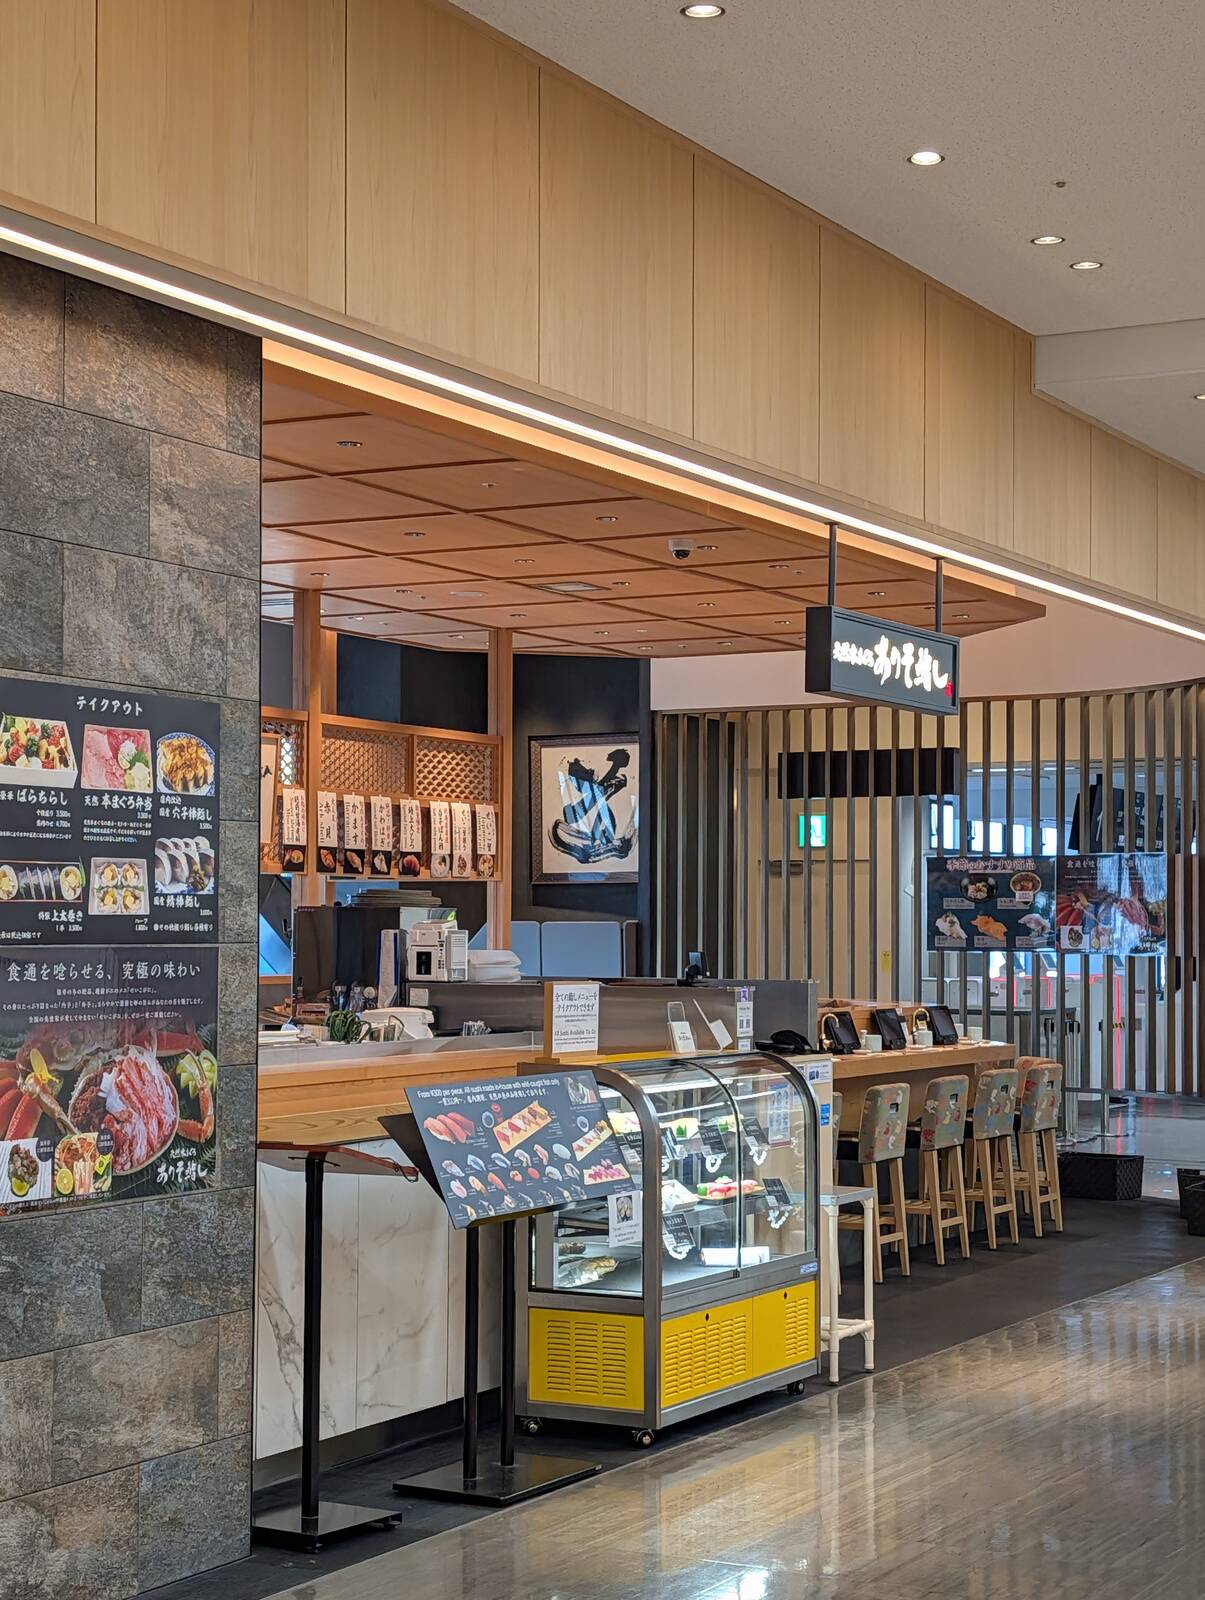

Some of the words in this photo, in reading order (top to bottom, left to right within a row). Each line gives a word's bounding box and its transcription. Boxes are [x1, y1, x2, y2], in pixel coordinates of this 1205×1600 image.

[76, 696, 143, 717] テイクアウト
[17, 789, 68, 806] ばらちらし
[101, 793, 152, 811] 本まぐろ弁当
[351, 802, 359, 846] かます
[51, 909, 83, 922] 上太巻き
[556, 1003, 595, 1013] テイクアウトできます
[417, 1090, 430, 1099] From
[442, 1089, 451, 1097] per
[156, 1160, 209, 1186] ありそ鮨し
